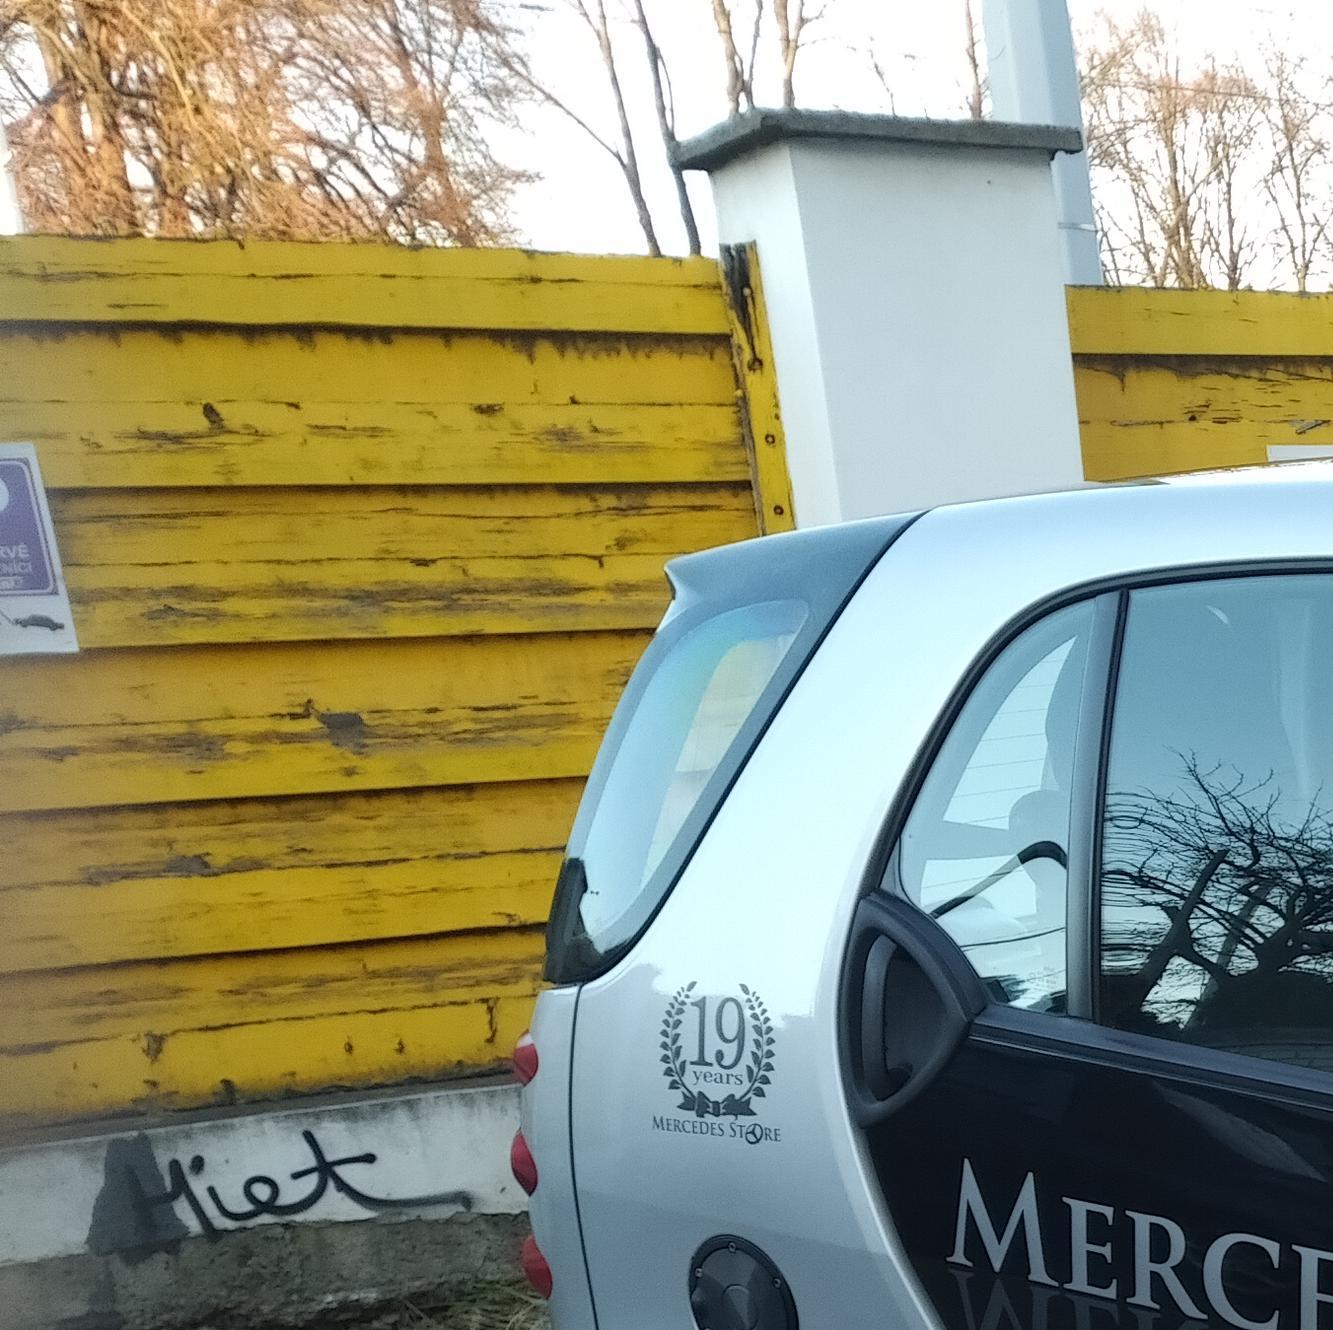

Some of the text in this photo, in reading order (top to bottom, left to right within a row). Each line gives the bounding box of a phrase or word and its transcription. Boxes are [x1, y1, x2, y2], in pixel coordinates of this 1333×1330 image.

[688, 995, 746, 1070] 19
[690, 1069, 744, 1086] years
[652, 1115, 725, 1137] MERCEDES
